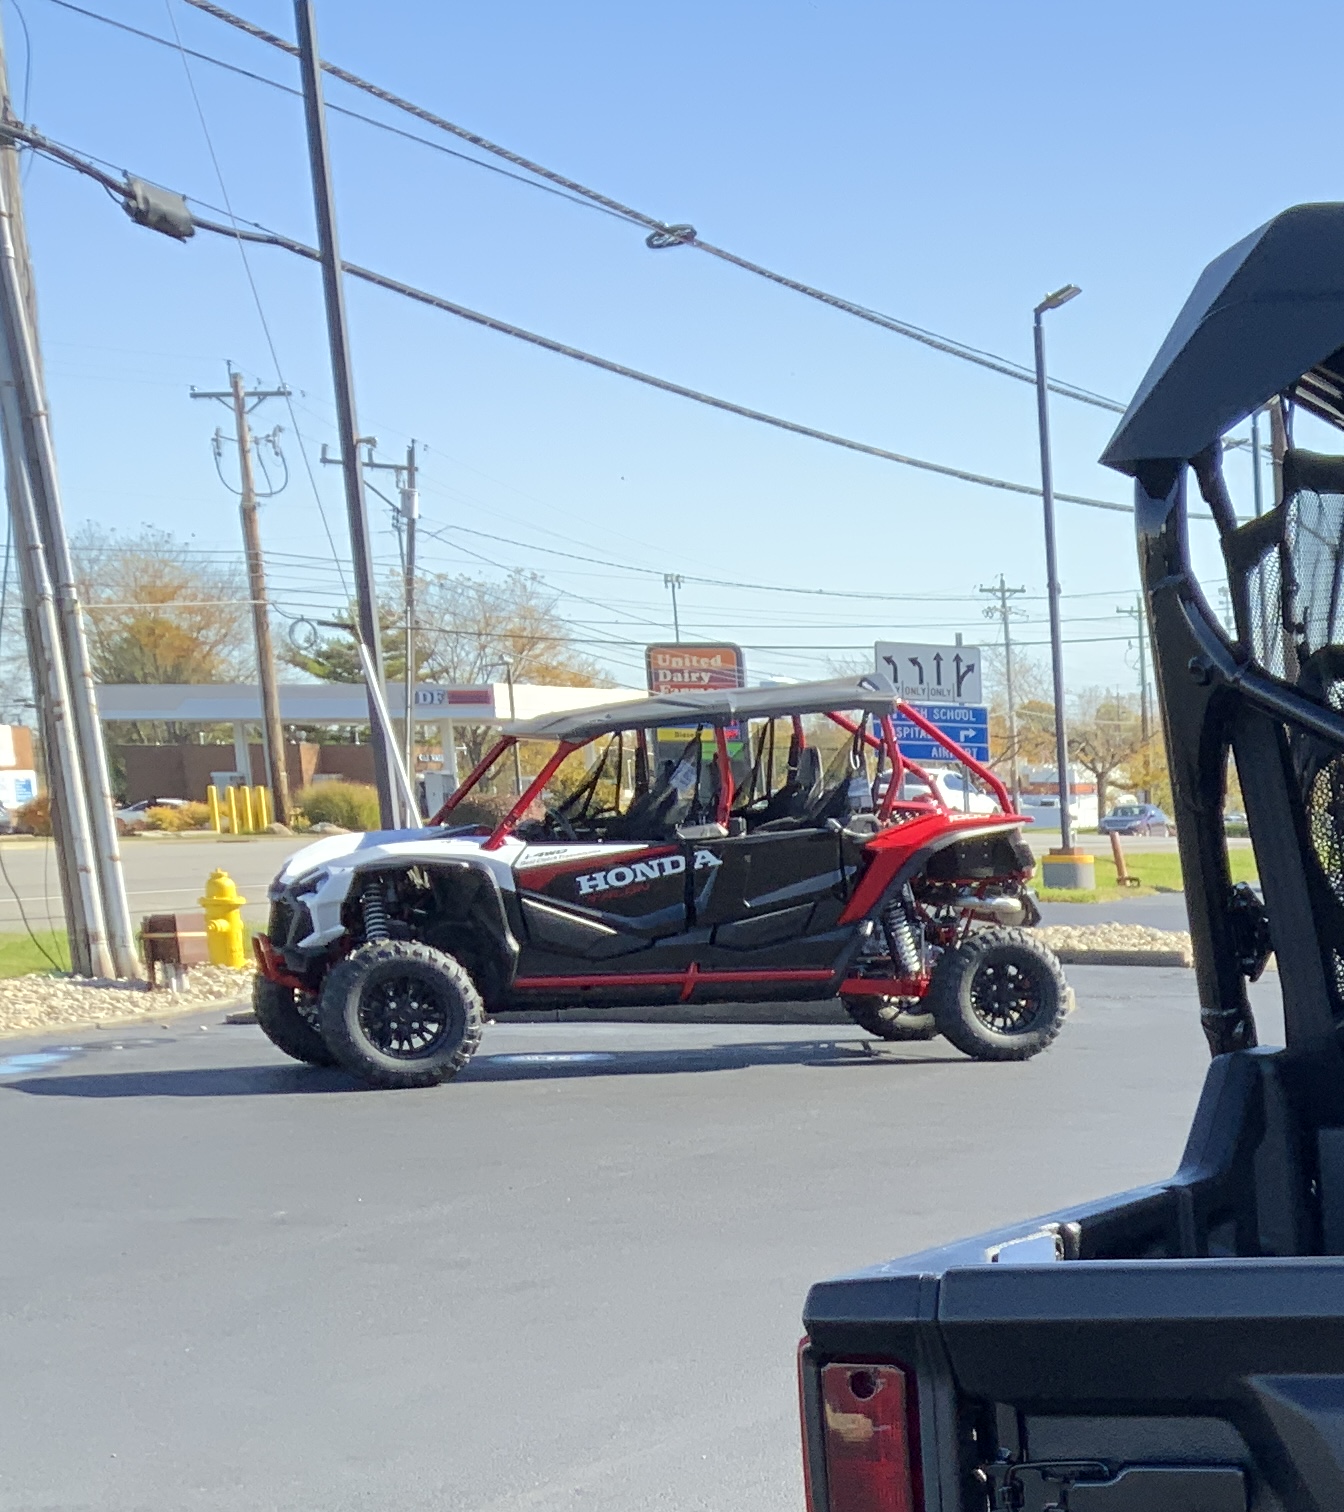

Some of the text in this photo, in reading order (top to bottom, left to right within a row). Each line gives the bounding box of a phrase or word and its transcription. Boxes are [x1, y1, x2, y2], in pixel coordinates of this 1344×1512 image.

[657, 654, 722, 667] United
[659, 669, 712, 684] Dairy
[904, 687, 926, 696] ONLY
[930, 688, 951, 697] ONLY
[933, 709, 976, 722] SCHOOL
[575, 850, 724, 895] HONDA
